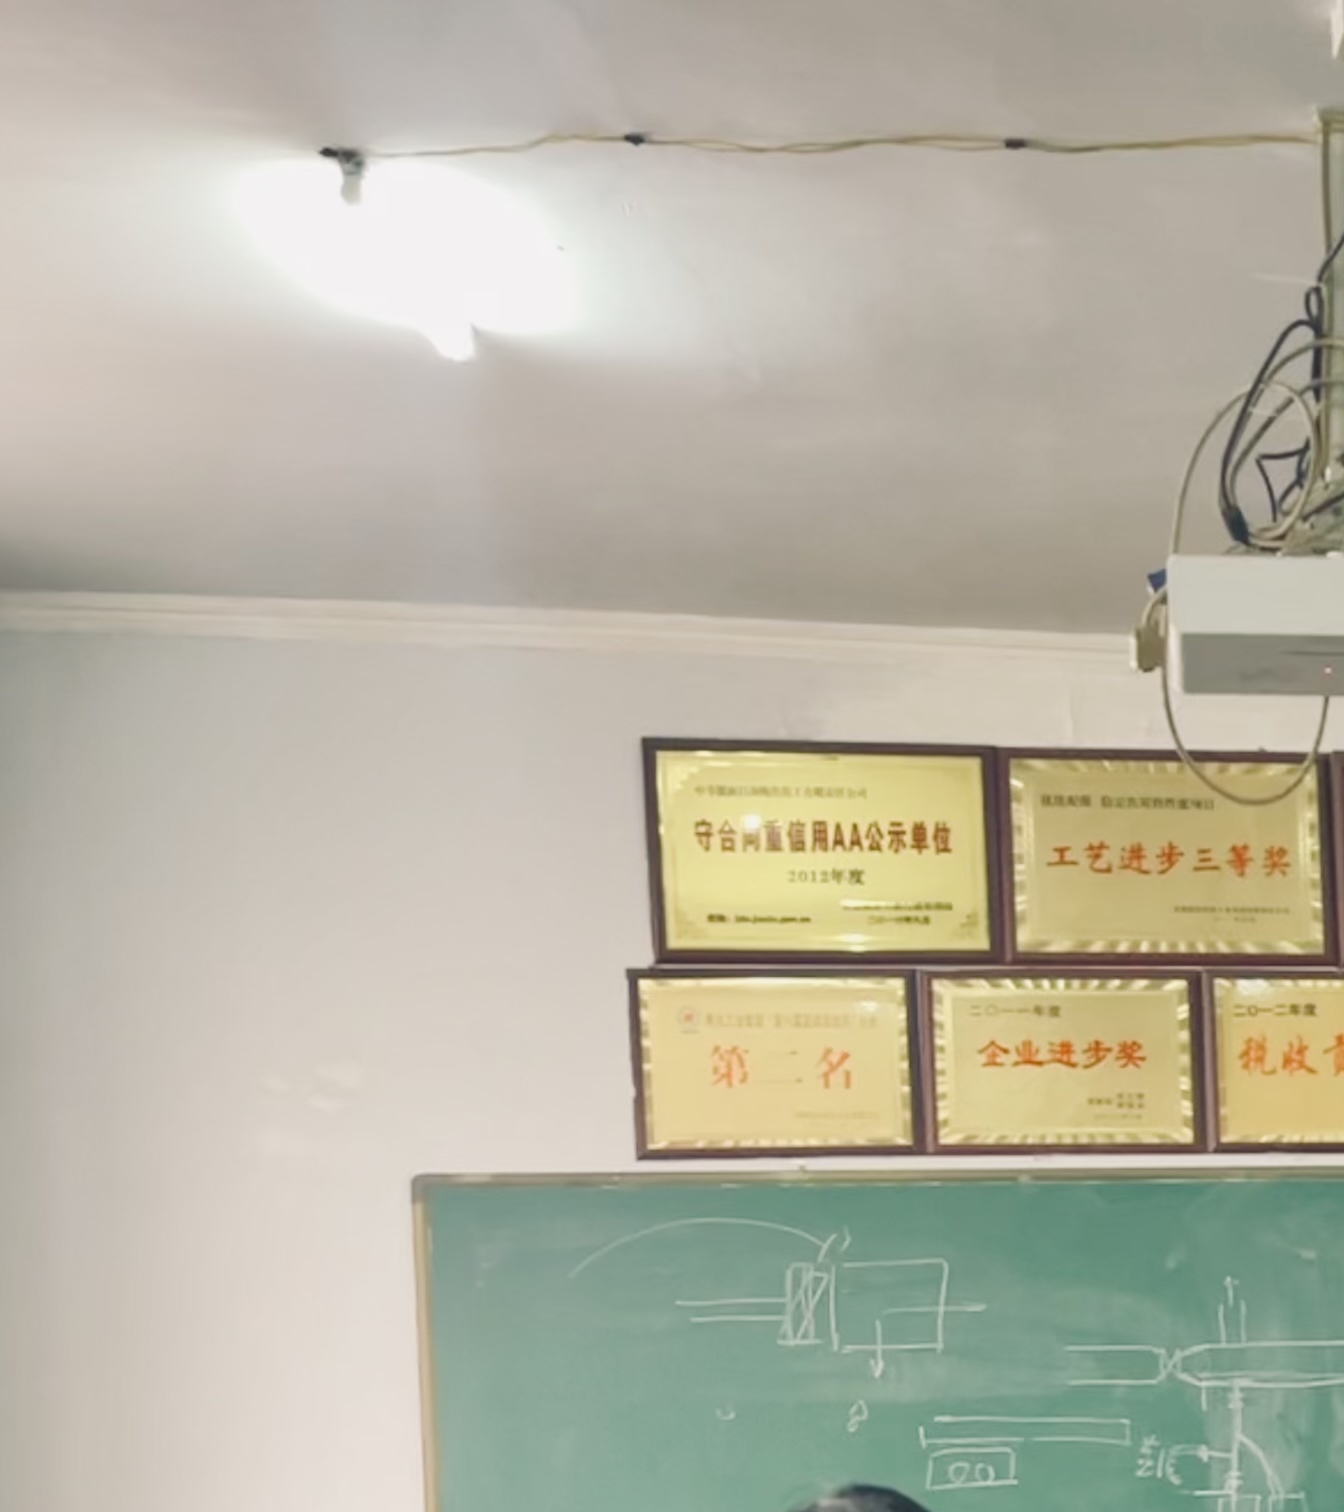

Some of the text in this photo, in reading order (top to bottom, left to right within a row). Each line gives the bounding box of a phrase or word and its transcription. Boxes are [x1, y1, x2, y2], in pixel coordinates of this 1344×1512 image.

[694, 819, 953, 854] 守合同重信用AA公示单位
[1047, 841, 1292, 877] 工艺进步三等奖
[787, 868, 866, 886] 2012年度
[977, 1040, 1147, 1069] 企业进步奖
